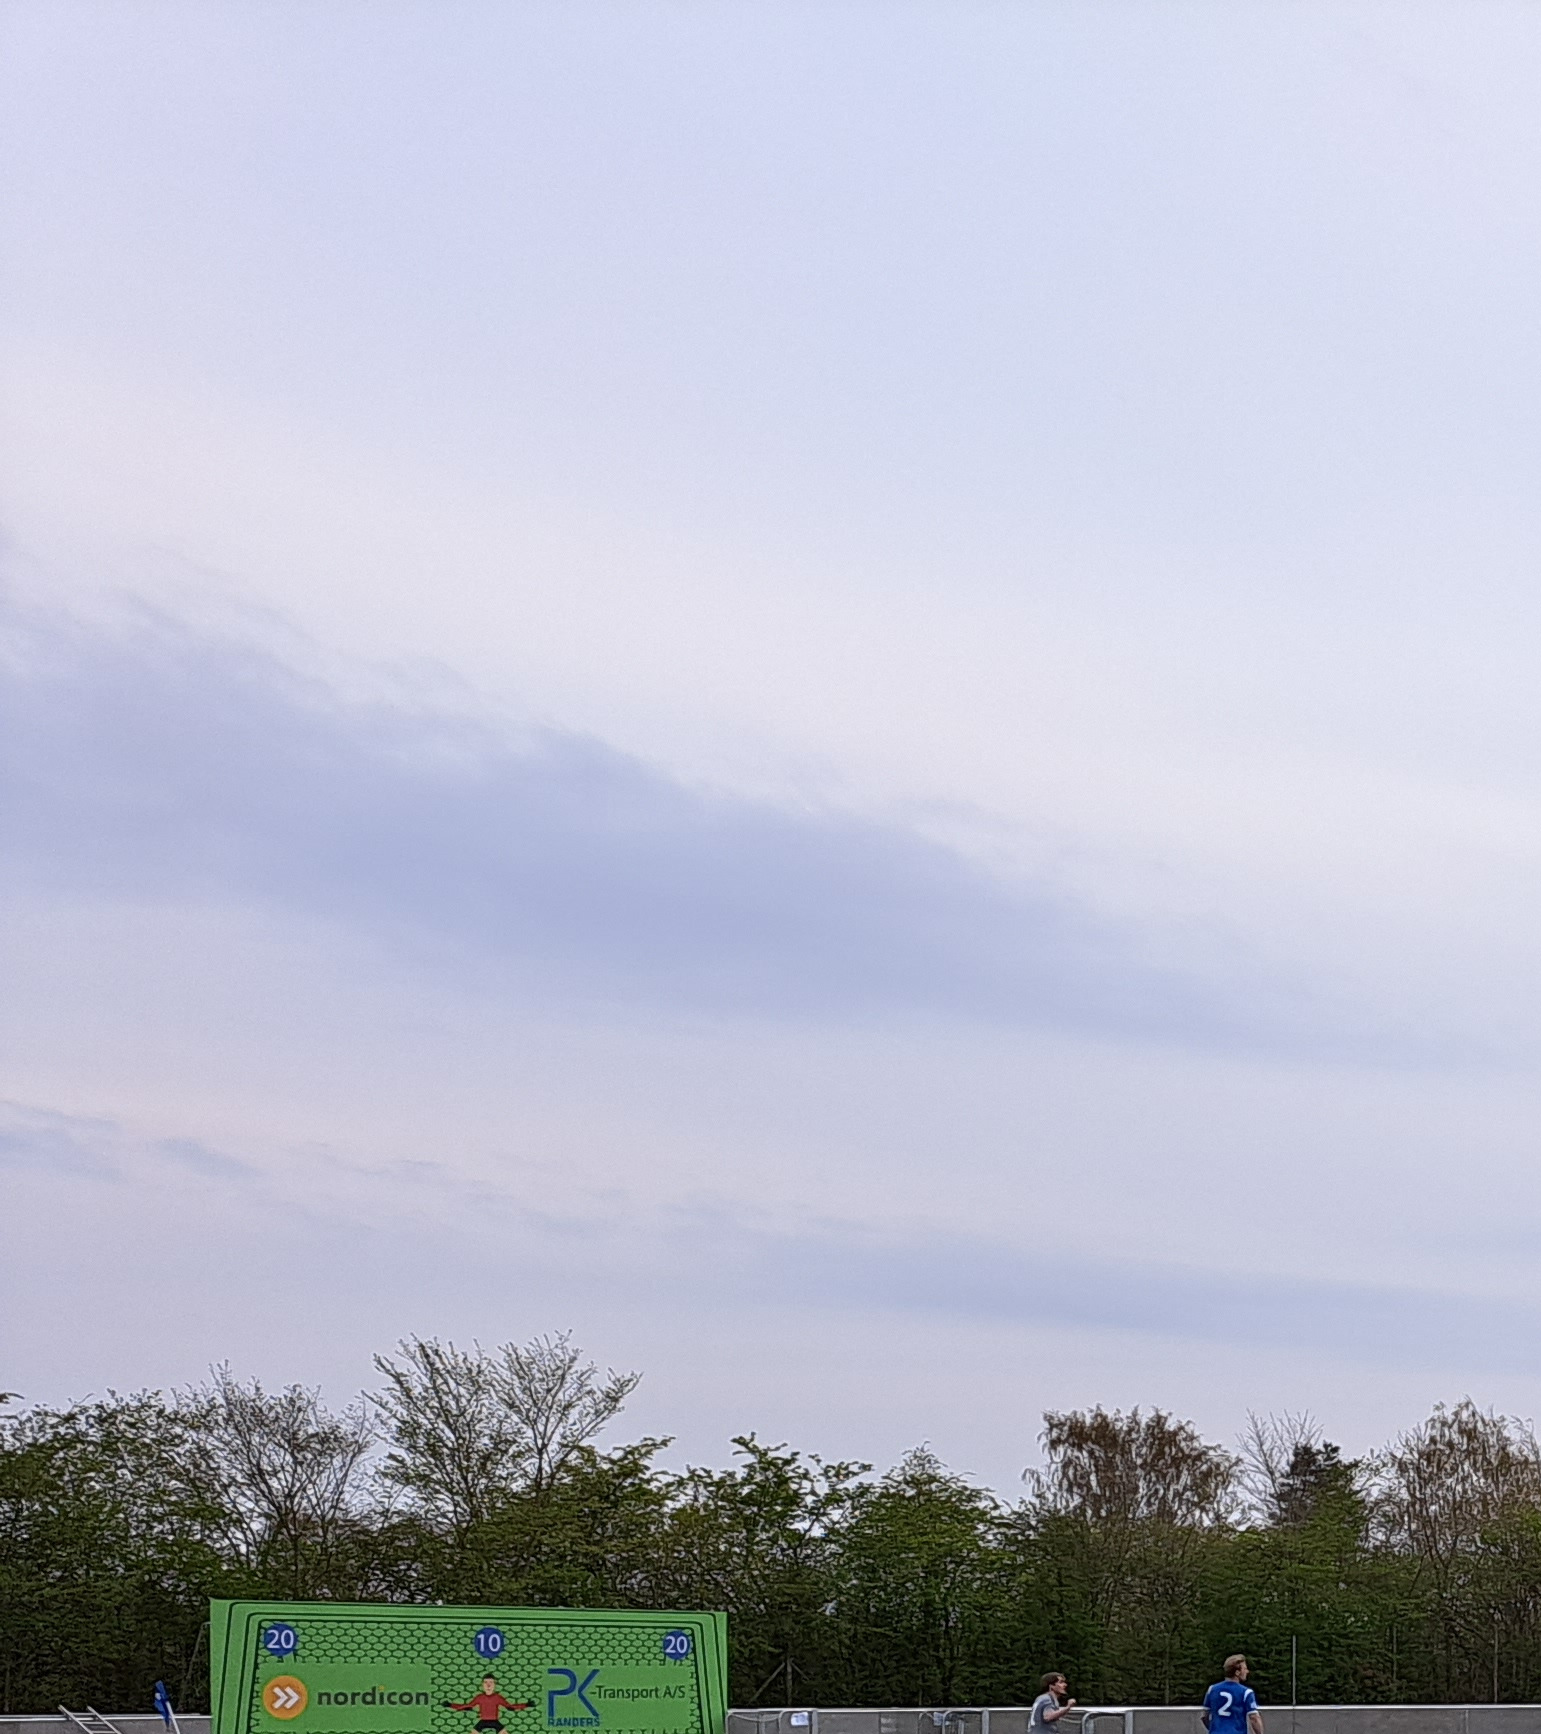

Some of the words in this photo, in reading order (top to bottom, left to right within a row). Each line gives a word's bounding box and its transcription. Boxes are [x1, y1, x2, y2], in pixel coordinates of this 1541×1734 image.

[267, 1629, 295, 1650] 20
[477, 1632, 501, 1652] 10
[665, 1635, 689, 1654] 20
[317, 1685, 430, 1706] nordicon
[663, 1685, 686, 1699] A/S
[1218, 1692, 1232, 1716] 2
[547, 1717, 600, 1728] RANDERS
